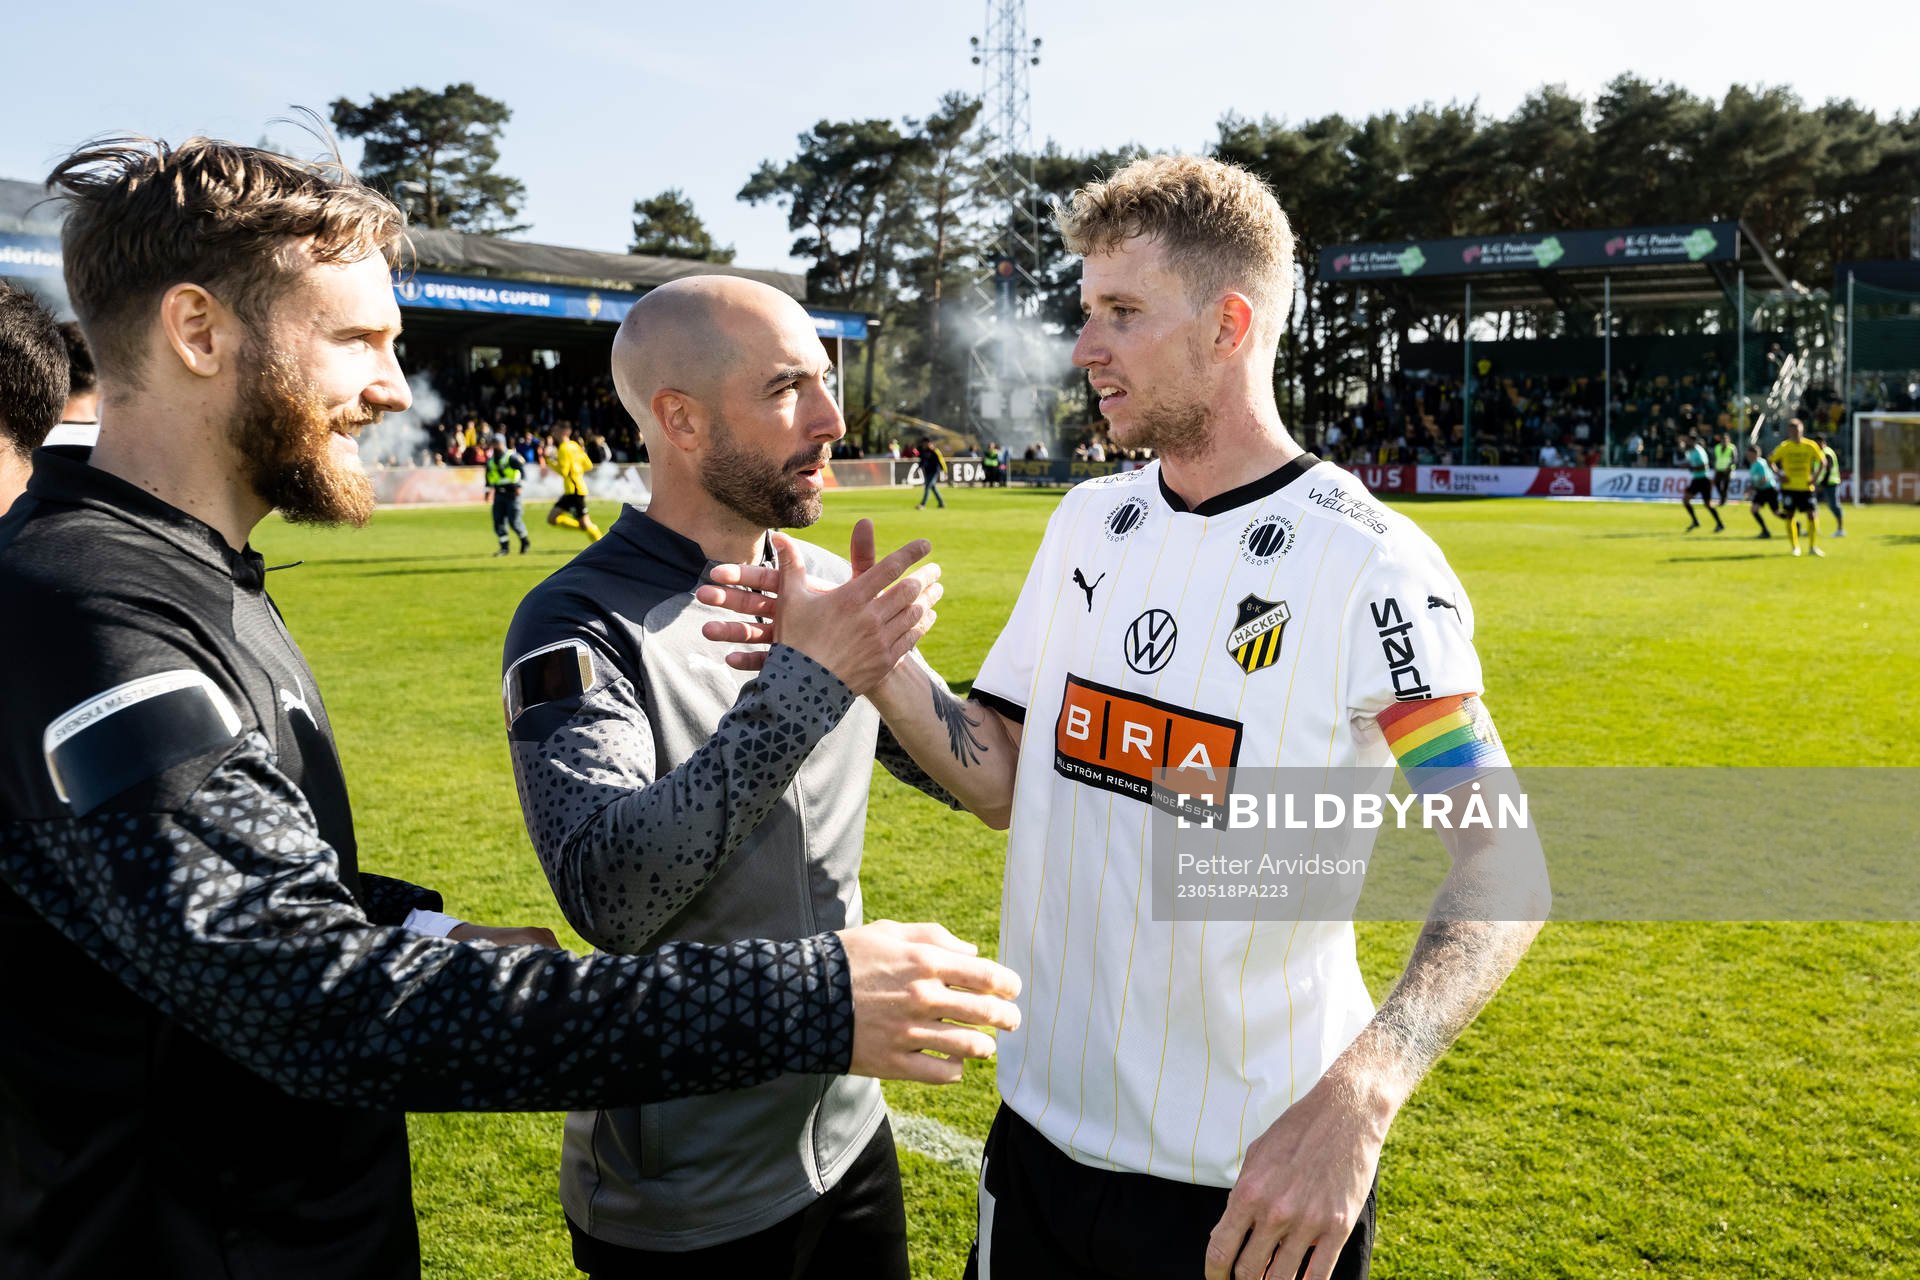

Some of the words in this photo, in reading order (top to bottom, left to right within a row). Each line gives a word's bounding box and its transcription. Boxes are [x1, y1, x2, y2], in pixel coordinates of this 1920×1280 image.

[424, 283, 498, 303] SVENSKA
[500, 289, 550, 308] CUPEN
[1308, 487, 1388, 535] WELLNESS
[1329, 487, 1384, 519] NORDIC
[1239, 518, 1260, 545] SANKT
[1264, 514, 1294, 532] JÖRGEN
[1281, 533, 1296, 556] PARK
[1241, 552, 1275, 567] RESORT
[1234, 609, 1285, 644] HÄCKEN
[55, 706, 104, 740] SVENSKA
[1056, 755, 1102, 781] BILLSTRÖM
[1106, 774, 1148, 795] RIEMER
